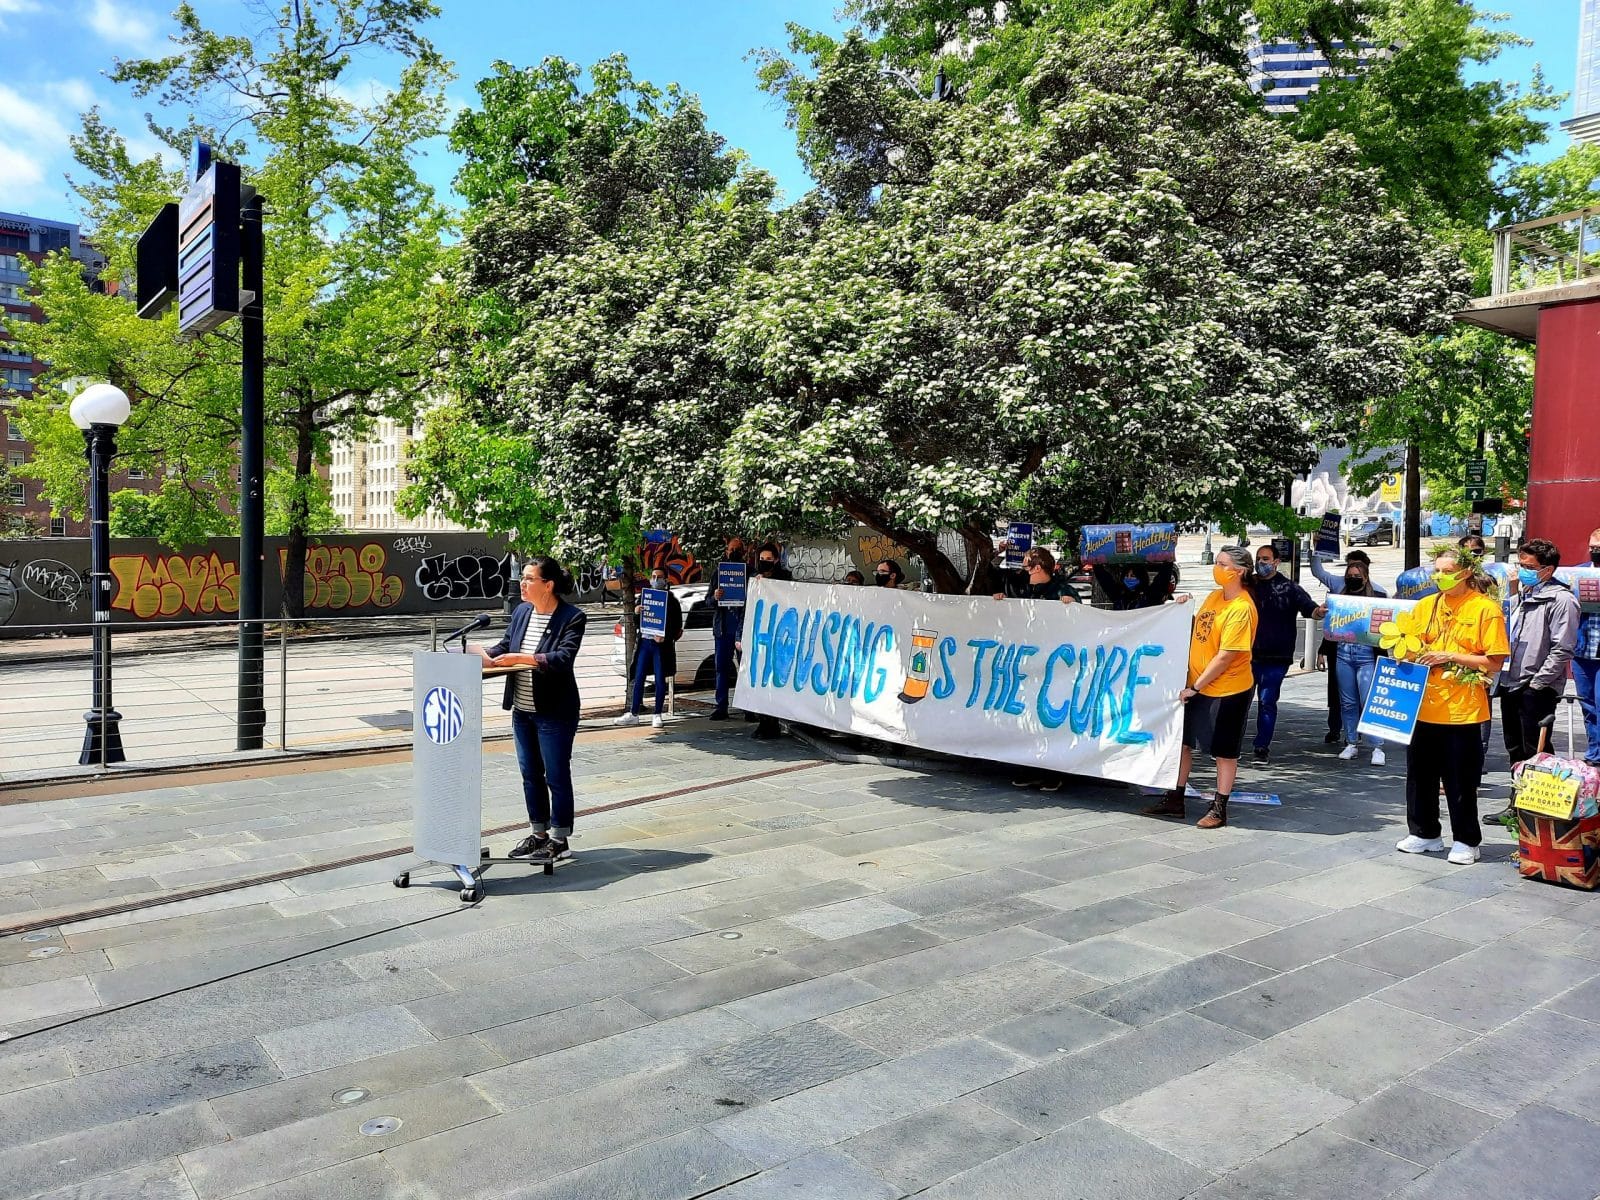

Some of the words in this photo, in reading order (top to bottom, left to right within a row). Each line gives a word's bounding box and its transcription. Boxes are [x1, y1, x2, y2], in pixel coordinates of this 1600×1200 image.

[1323, 520, 1339, 529] STOP
[1085, 533, 1113, 557] Housed
[1134, 529, 1172, 554] Healthy
[643, 599, 665, 607] DESERVE
[643, 617, 662, 625] HOUSED
[1330, 604, 1370, 632] Housed
[750, 599, 893, 704] HOUSING
[967, 639, 1039, 715] THE
[1037, 643, 1165, 744] CURE
[1381, 666, 1396, 675] WE
[1378, 676, 1420, 691] DESERVE
[1376, 685, 1388, 695] TO
[1372, 696, 1396, 707] STAY
[1369, 705, 1408, 721] HOUSED
